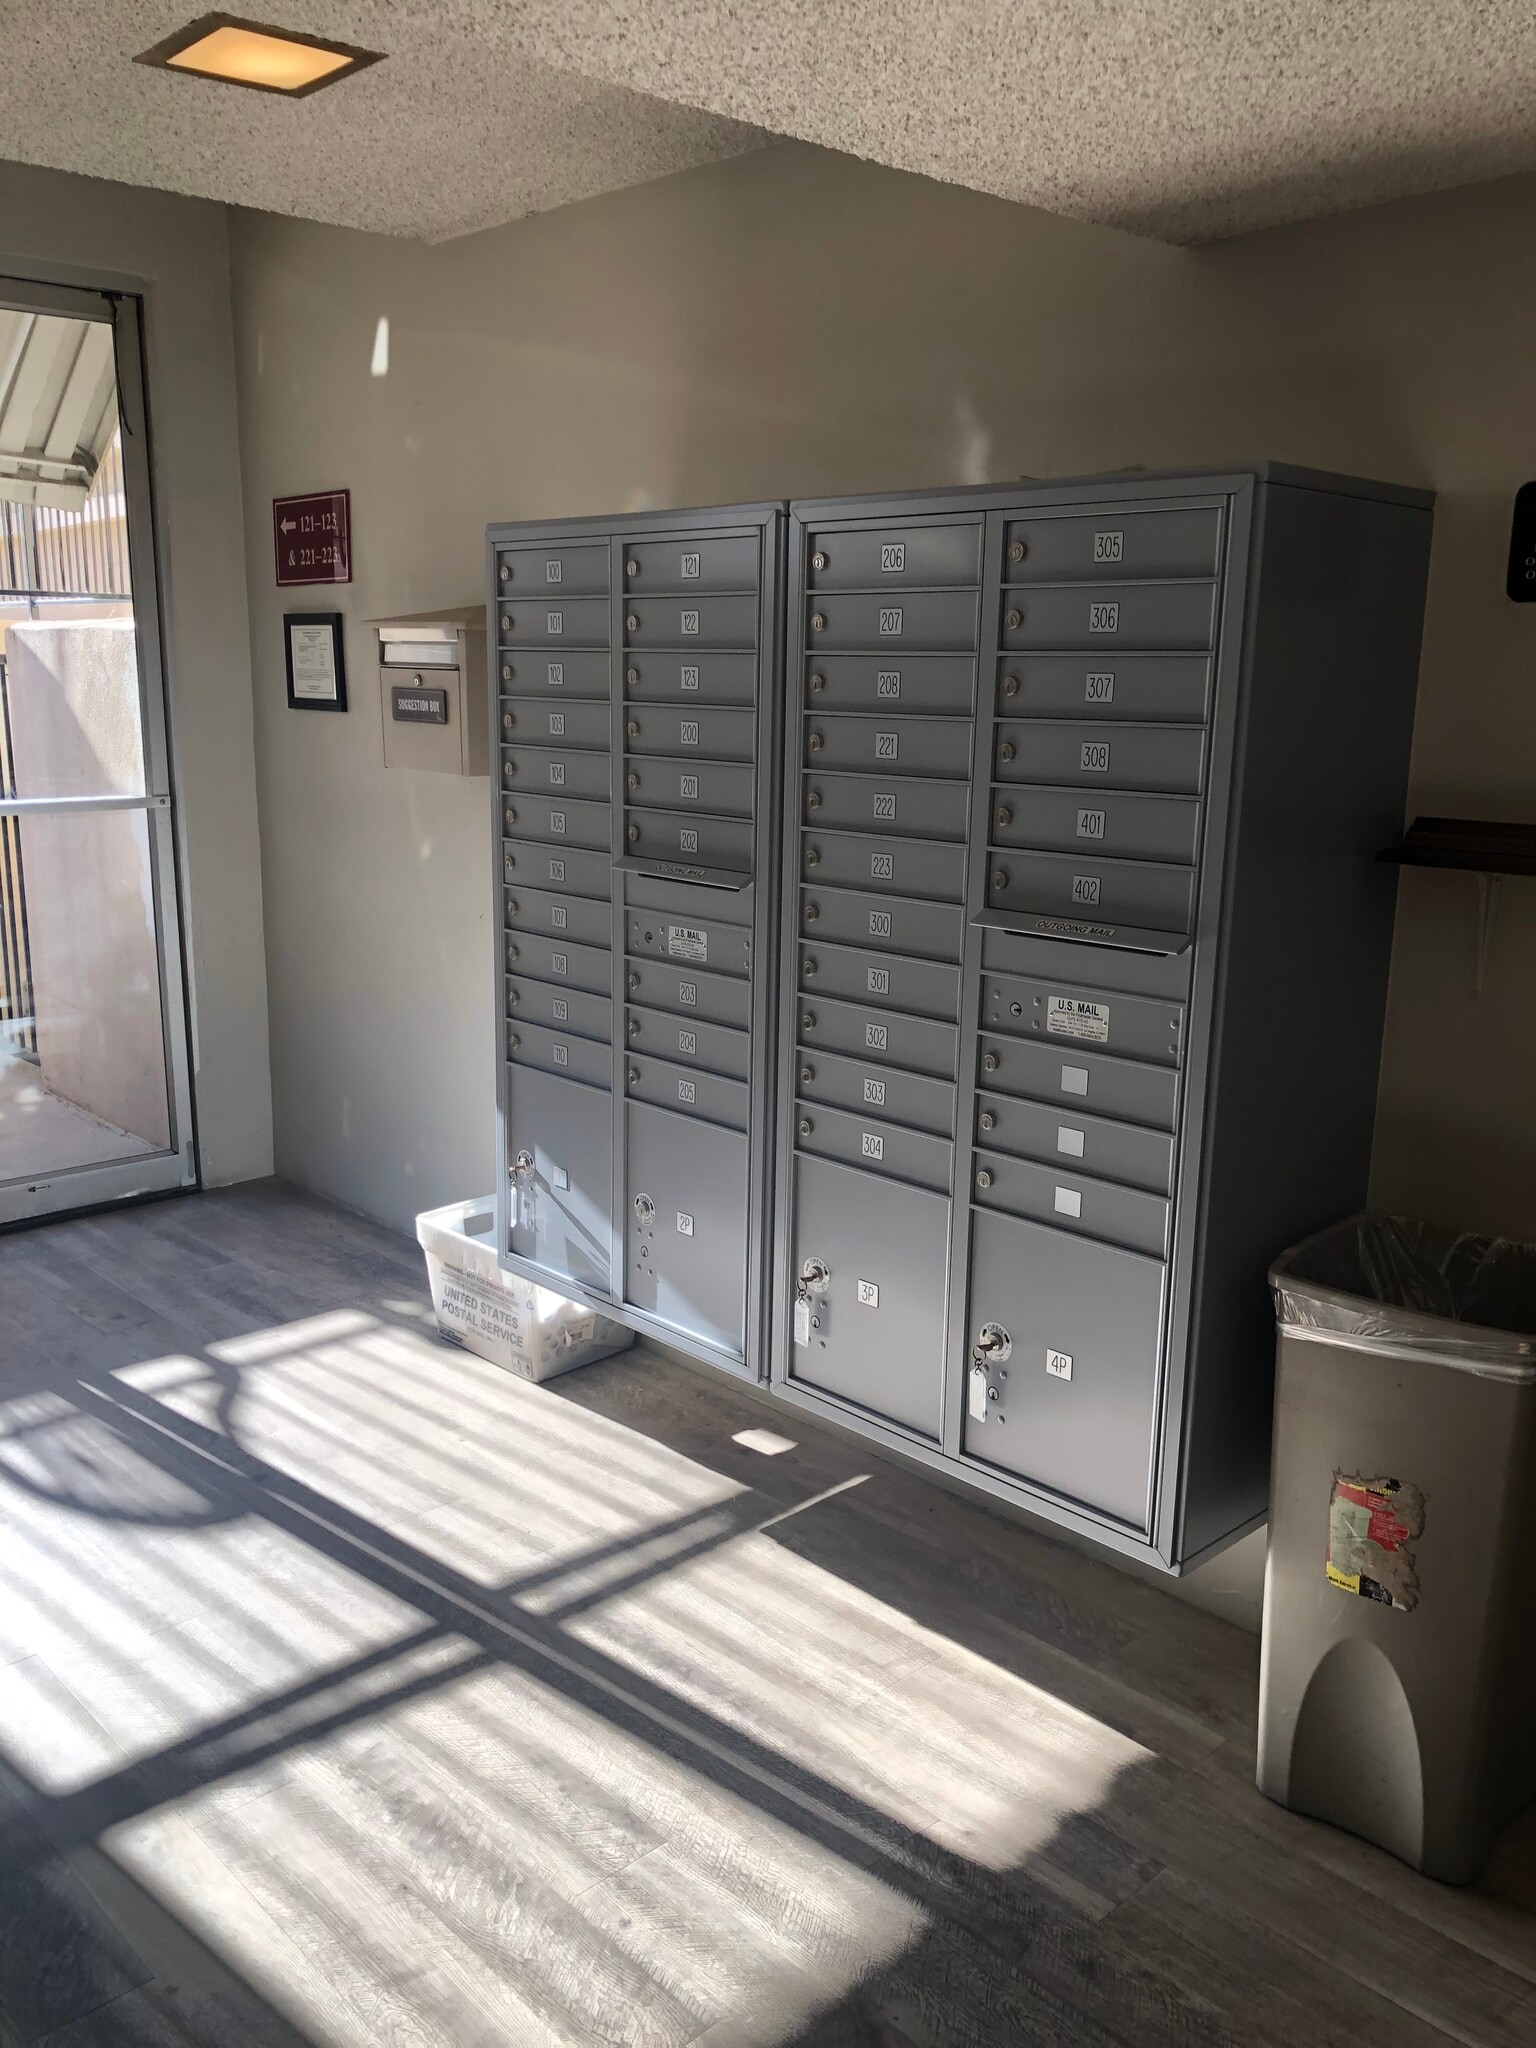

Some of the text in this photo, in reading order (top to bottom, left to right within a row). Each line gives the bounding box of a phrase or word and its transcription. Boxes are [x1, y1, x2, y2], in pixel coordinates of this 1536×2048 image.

[1096, 536, 1120, 558] 305
[288, 550, 296, 566] &
[684, 558, 697, 575] 121
[883, 547, 904, 568] 206
[550, 615, 562, 631] 101
[684, 614, 696, 632] 122
[881, 612, 900, 632] 207
[1092, 606, 1116, 629] 306
[550, 666, 562, 682] 102
[684, 670, 696, 687] 123
[880, 675, 898, 696] 208
[1088, 677, 1112, 699] 307
[398, 698, 440, 712] SUGGESTION BOX
[552, 716, 563, 732] 103
[682, 724, 697, 742] 200
[878, 737, 895, 757] 221
[1084, 746, 1106, 768] 308
[552, 766, 563, 782] 104
[683, 778, 696, 796] 201
[875, 797, 894, 817] 222
[552, 814, 564, 831] 105
[1080, 813, 1101, 834] 401
[682, 833, 696, 850] 202
[552, 863, 564, 879] 106
[873, 856, 891, 876] 223
[1074, 880, 1097, 901] 402
[554, 910, 564, 926] 107
[870, 914, 889, 934] 300
[675, 928, 686, 938] U.S.
[687, 930, 701, 940] MAIL
[1037, 920, 1113, 937] OUTGOING MAIL
[554, 956, 565, 973] 108
[870, 972, 887, 990] 301
[681, 984, 695, 1002] 203
[554, 1002, 566, 1018] 109
[1058, 1000, 1099, 1016] U.S. MAIL
[680, 1034, 694, 1052] 204
[868, 1028, 886, 1046] 302
[556, 1047, 566, 1064] 110
[680, 1083, 694, 1101] 205
[866, 1082, 884, 1102] 303
[864, 1136, 882, 1156] 304
[680, 1216, 690, 1231] 2P
[810, 1258, 823, 1267] OPEN
[862, 1284, 874, 1302] 3P
[444, 1284, 478, 1310] UNITED
[480, 1302, 518, 1329] STATES
[442, 1300, 478, 1326] POSTAL
[480, 1318, 524, 1348] SERVICE
[988, 1324, 1004, 1334] OPEN
[1052, 1355, 1066, 1374] 4P
